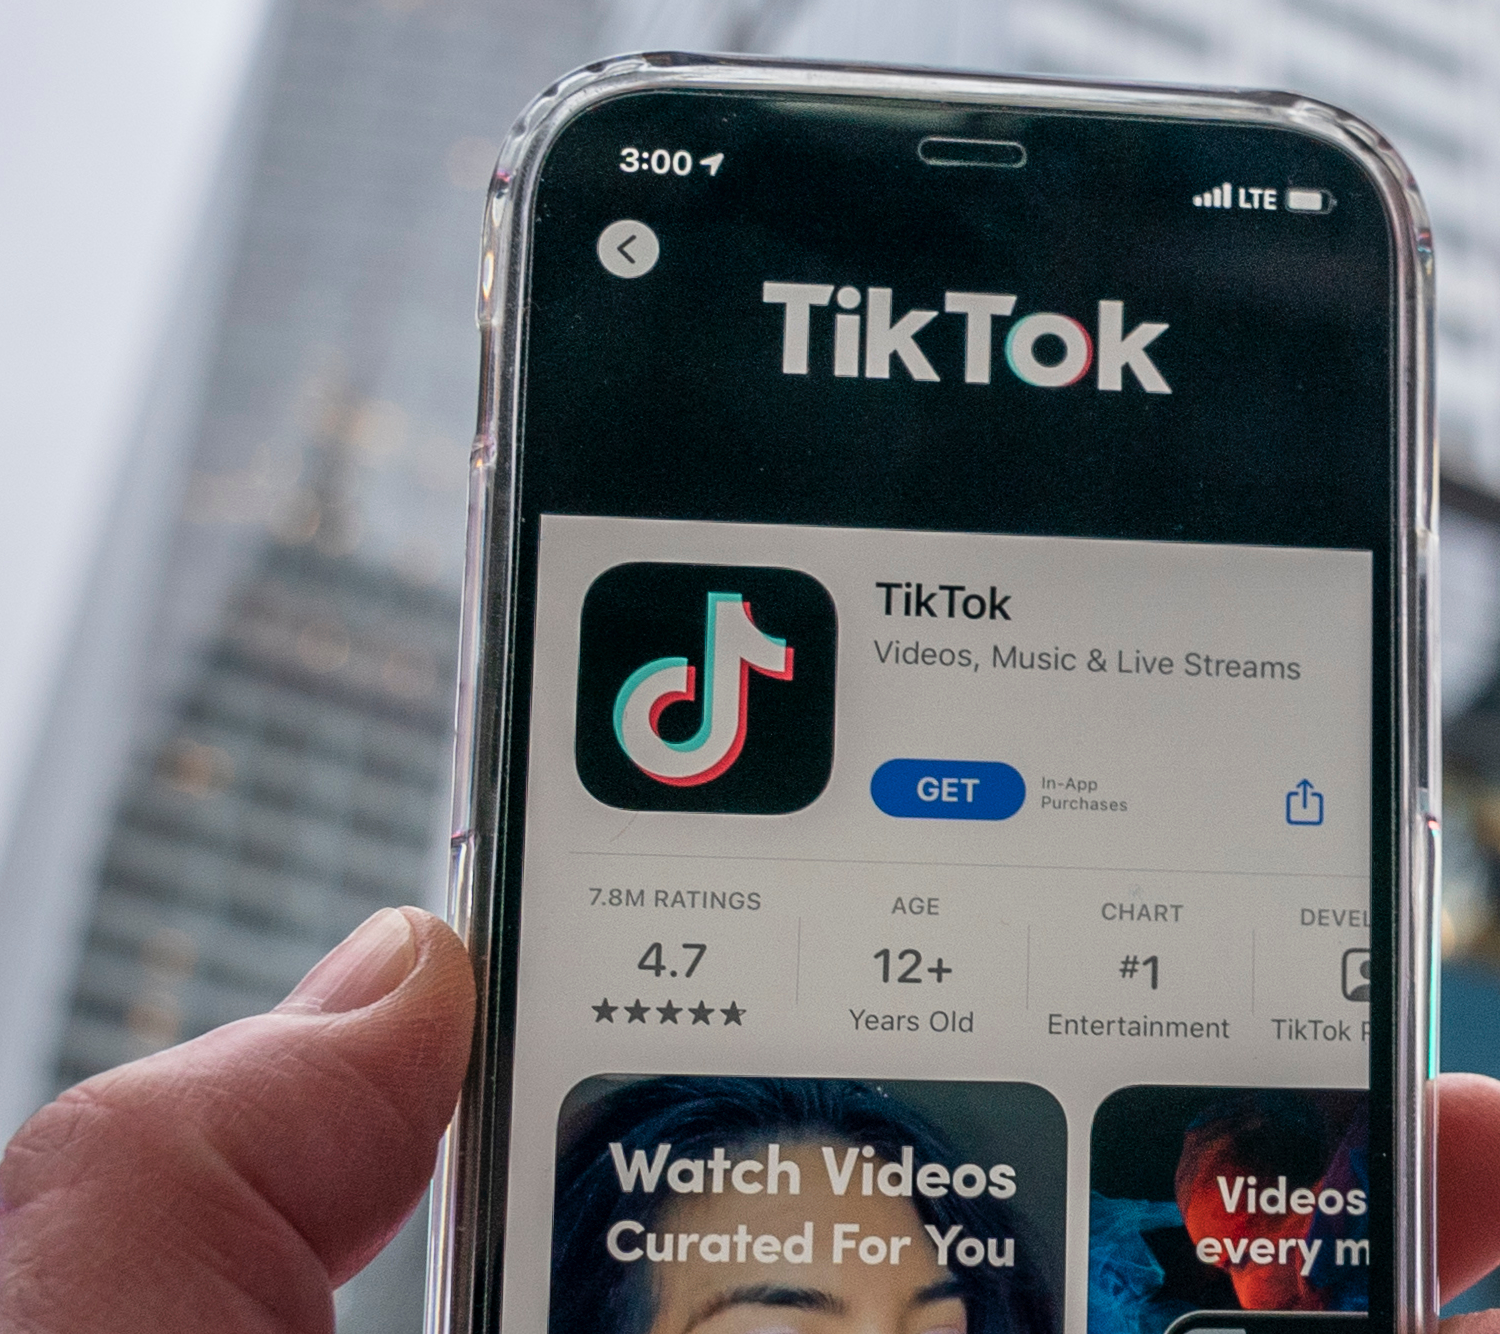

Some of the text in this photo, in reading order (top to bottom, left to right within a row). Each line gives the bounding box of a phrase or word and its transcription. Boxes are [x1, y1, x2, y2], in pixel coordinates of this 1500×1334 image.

[619, 147, 693, 177] 3:00
[1238, 187, 1277, 211] LTE
[762, 281, 1173, 395] TikTok
[875, 581, 1012, 622] TikTok
[873, 640, 1302, 681] Videos, Music & Live Streams
[916, 776, 980, 803] GET
[1041, 776, 1098, 794] In-App
[1041, 796, 1128, 812] Purchases
[589, 887, 762, 911] 7.8M RATINGS
[891, 896, 940, 916] AGE
[1101, 902, 1185, 922] CHART
[637, 941, 708, 979] 4.7
[873, 948, 953, 984] 12+
[1119, 954, 1159, 990] #1
[849, 1008, 975, 1033] Years Old
[1048, 1013, 1231, 1039] Entertainment
[1271, 1018, 1352, 1042] TikTok
[609, 1142, 1018, 1199] Watch Videos
[1216, 1175, 1368, 1215] Videos
[606, 1220, 1016, 1267] Curated For You
[1196, 1236, 1323, 1277] every
